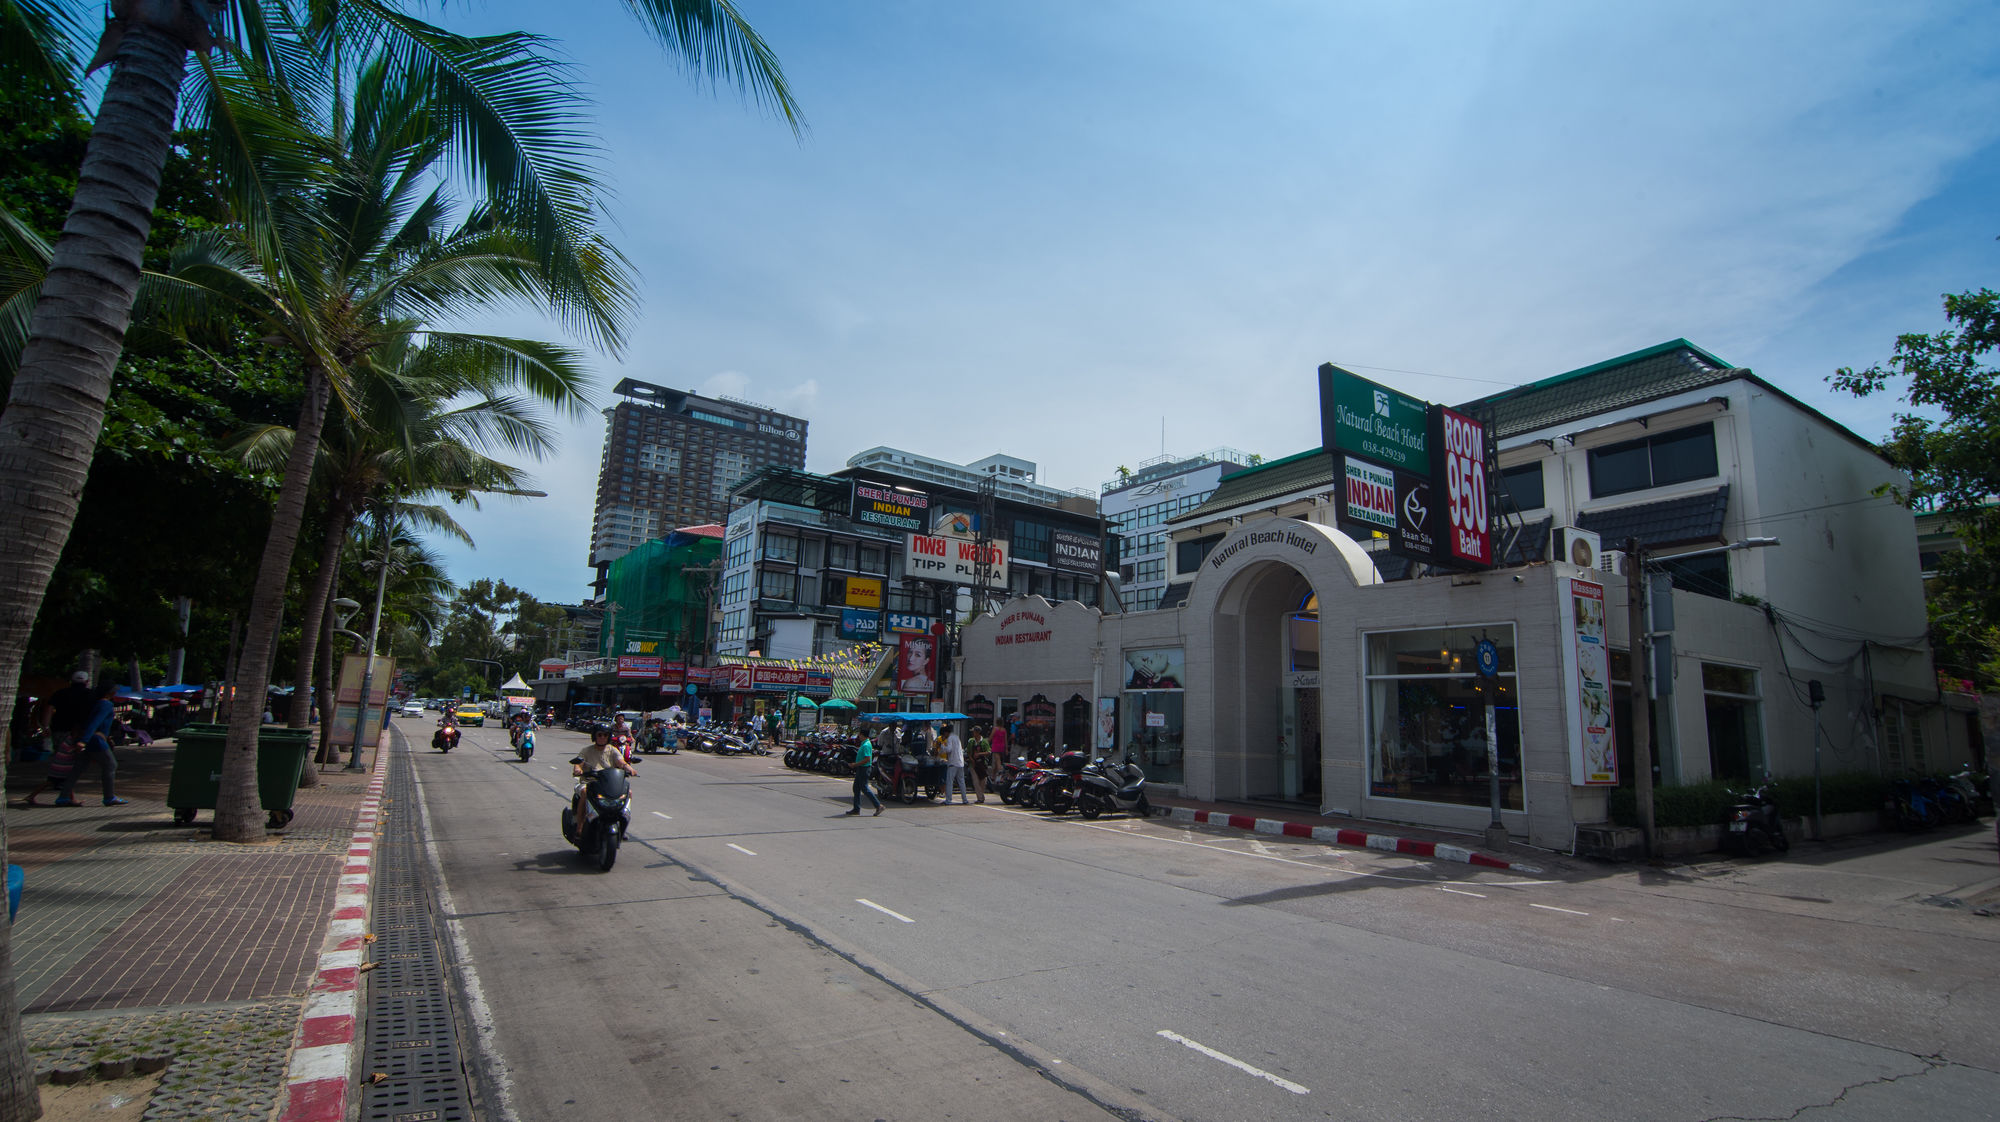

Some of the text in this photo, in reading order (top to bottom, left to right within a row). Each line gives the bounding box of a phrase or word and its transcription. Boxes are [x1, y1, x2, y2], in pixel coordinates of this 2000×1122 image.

[759, 424, 784, 436] Hilton
[1337, 405, 1374, 434] Natural
[1375, 418, 1400, 443] Beach
[1401, 429, 1425, 451] Hotel
[1444, 414, 1483, 463] ROOM
[1362, 440, 1406, 462] 038-429239
[1346, 465, 1393, 487] SHER E PUNJAB
[857, 487, 882, 500] SHER
[884, 492, 890, 501] E
[891, 493, 928, 508] PUNJAB
[1347, 477, 1394, 515] INDIAN
[1447, 452, 1487, 534] 950
[873, 501, 911, 516] INDIAN
[1349, 506, 1395, 526] RESTAURANT
[861, 511, 921, 530] RESTAURANT
[1401, 528, 1419, 540] Baan
[1459, 529, 1481, 558] Baht
[1056, 543, 1099, 561] INDIAN
[1212, 530, 1318, 569] Natural Beach Hotel
[913, 558, 946, 571] TIPP
[851, 588, 876, 597] DHL
[1572, 580, 1601, 597] Massage
[856, 619, 877, 630] PADI
[901, 616, 927, 629] ยา
[1001, 611, 1045, 630] SHER E PUNJAB
[626, 641, 658, 653] SUBWAY
[995, 630, 1052, 645] INDIAN RESTAURANT
